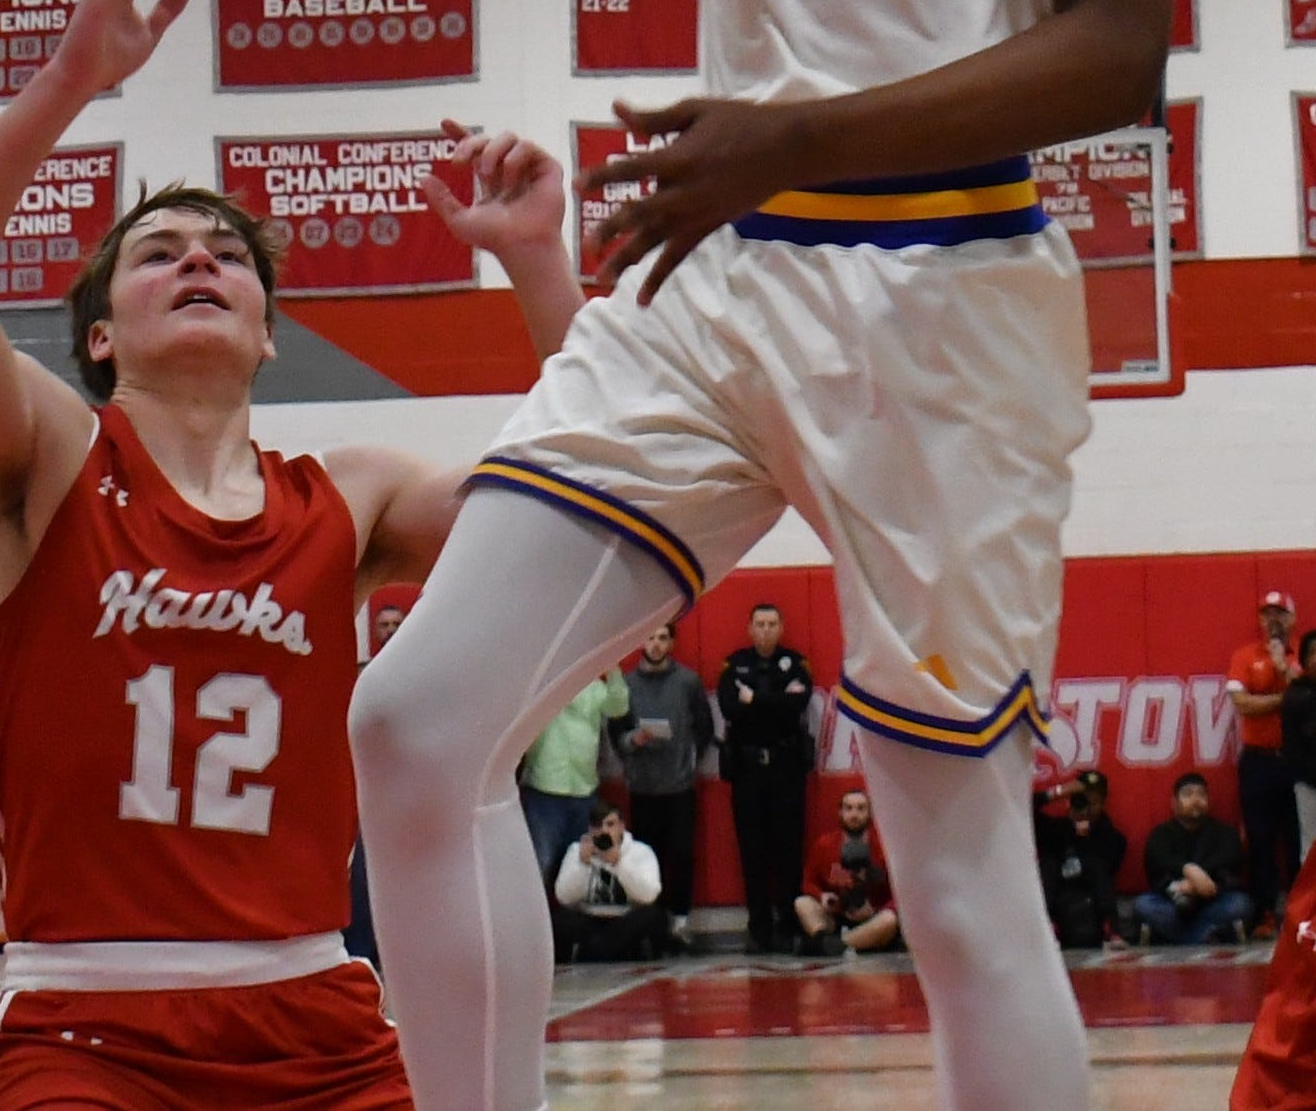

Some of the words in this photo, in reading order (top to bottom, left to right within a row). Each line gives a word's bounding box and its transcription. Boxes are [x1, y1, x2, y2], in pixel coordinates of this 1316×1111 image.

[229, 145, 328, 167] COLONIAL
[338, 140, 458, 165] CONFERENC
[34, 156, 113, 182] ERENCE
[270, 191, 429, 217] SOFTBALL
[4, 213, 72, 237] ENNIS
[92, 567, 313, 656] Hawks
[118, 663, 282, 836] 12
